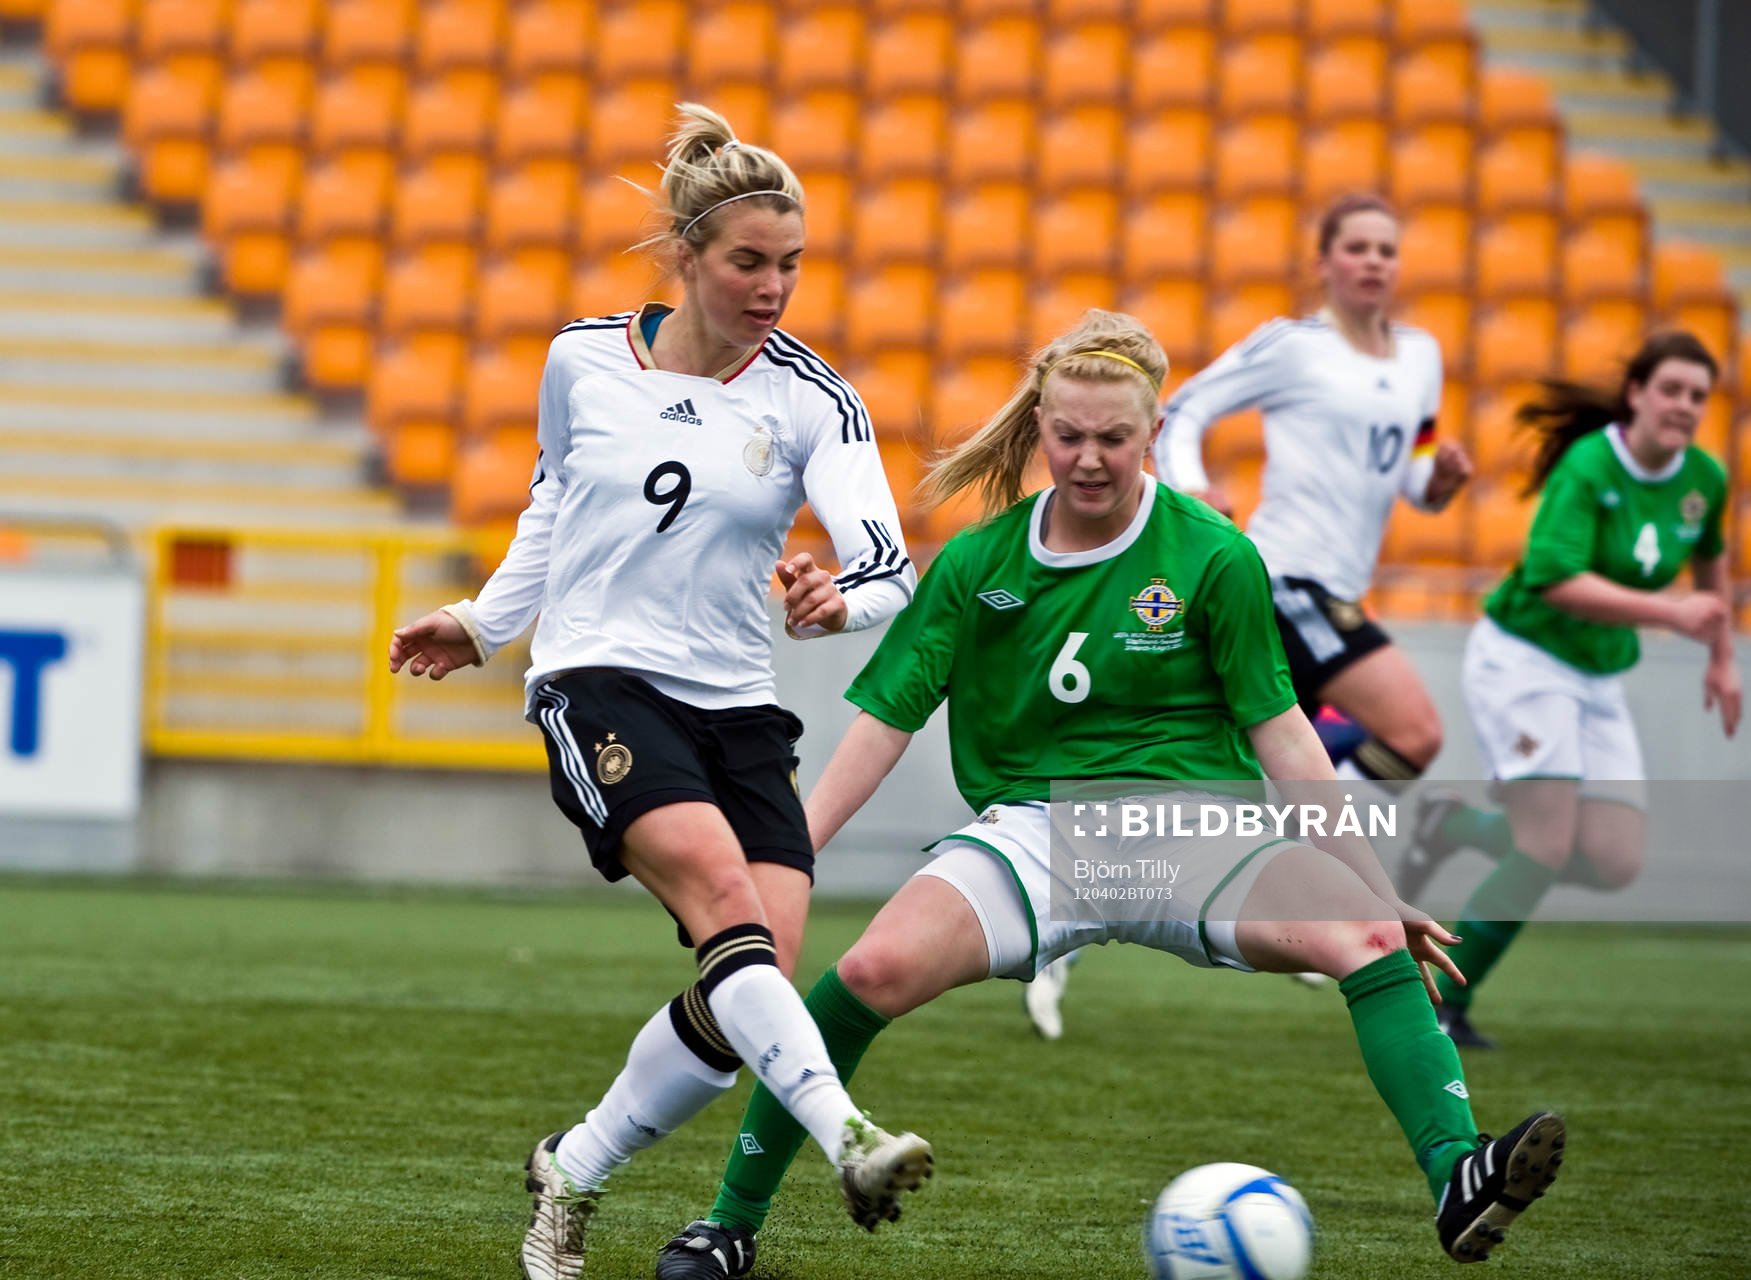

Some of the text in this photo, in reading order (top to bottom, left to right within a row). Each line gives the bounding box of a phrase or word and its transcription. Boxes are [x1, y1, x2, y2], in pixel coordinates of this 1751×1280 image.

[660, 411, 702, 426] adidas
[1368, 423, 1404, 475] 10
[643, 460, 692, 533] 9
[1633, 522, 1661, 577] 4
[1048, 631, 1091, 704] 6
